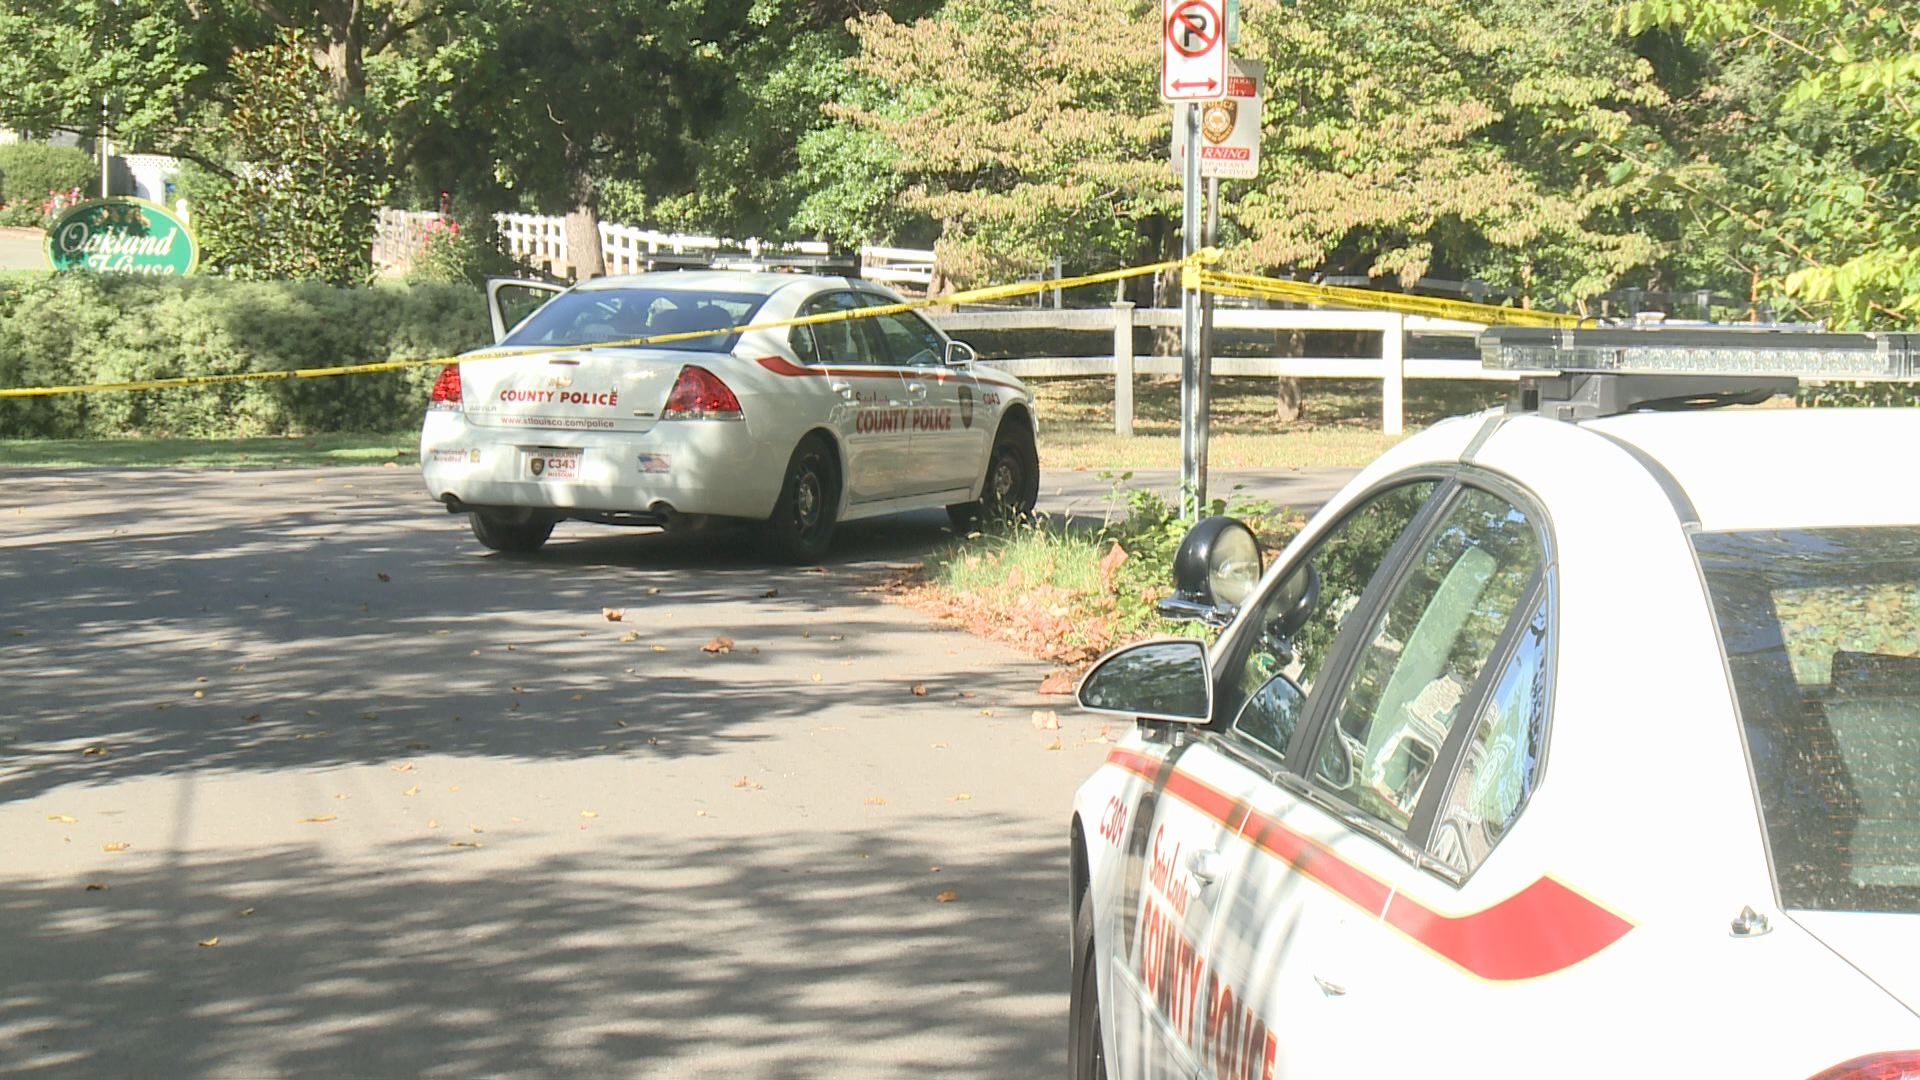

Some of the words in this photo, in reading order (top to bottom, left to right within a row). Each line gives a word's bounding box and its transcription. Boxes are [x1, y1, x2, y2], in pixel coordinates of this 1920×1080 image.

[1203, 147, 1248, 159] RNING
[60, 222, 177, 257] Oakland
[500, 390, 554, 402] COUNTY
[560, 391, 618, 406] POLICE
[501, 417, 615, 429] www.stlouisco.com/police
[856, 409, 908, 433] COUNTY
[912, 408, 952, 431] POLICE
[548, 459, 576, 469] C343
[1100, 795, 1128, 848] C309
[1149, 823, 1171, 897] Saint
[1166, 841, 1188, 919] Louis
[1140, 895, 1204, 1049] COUNTY
